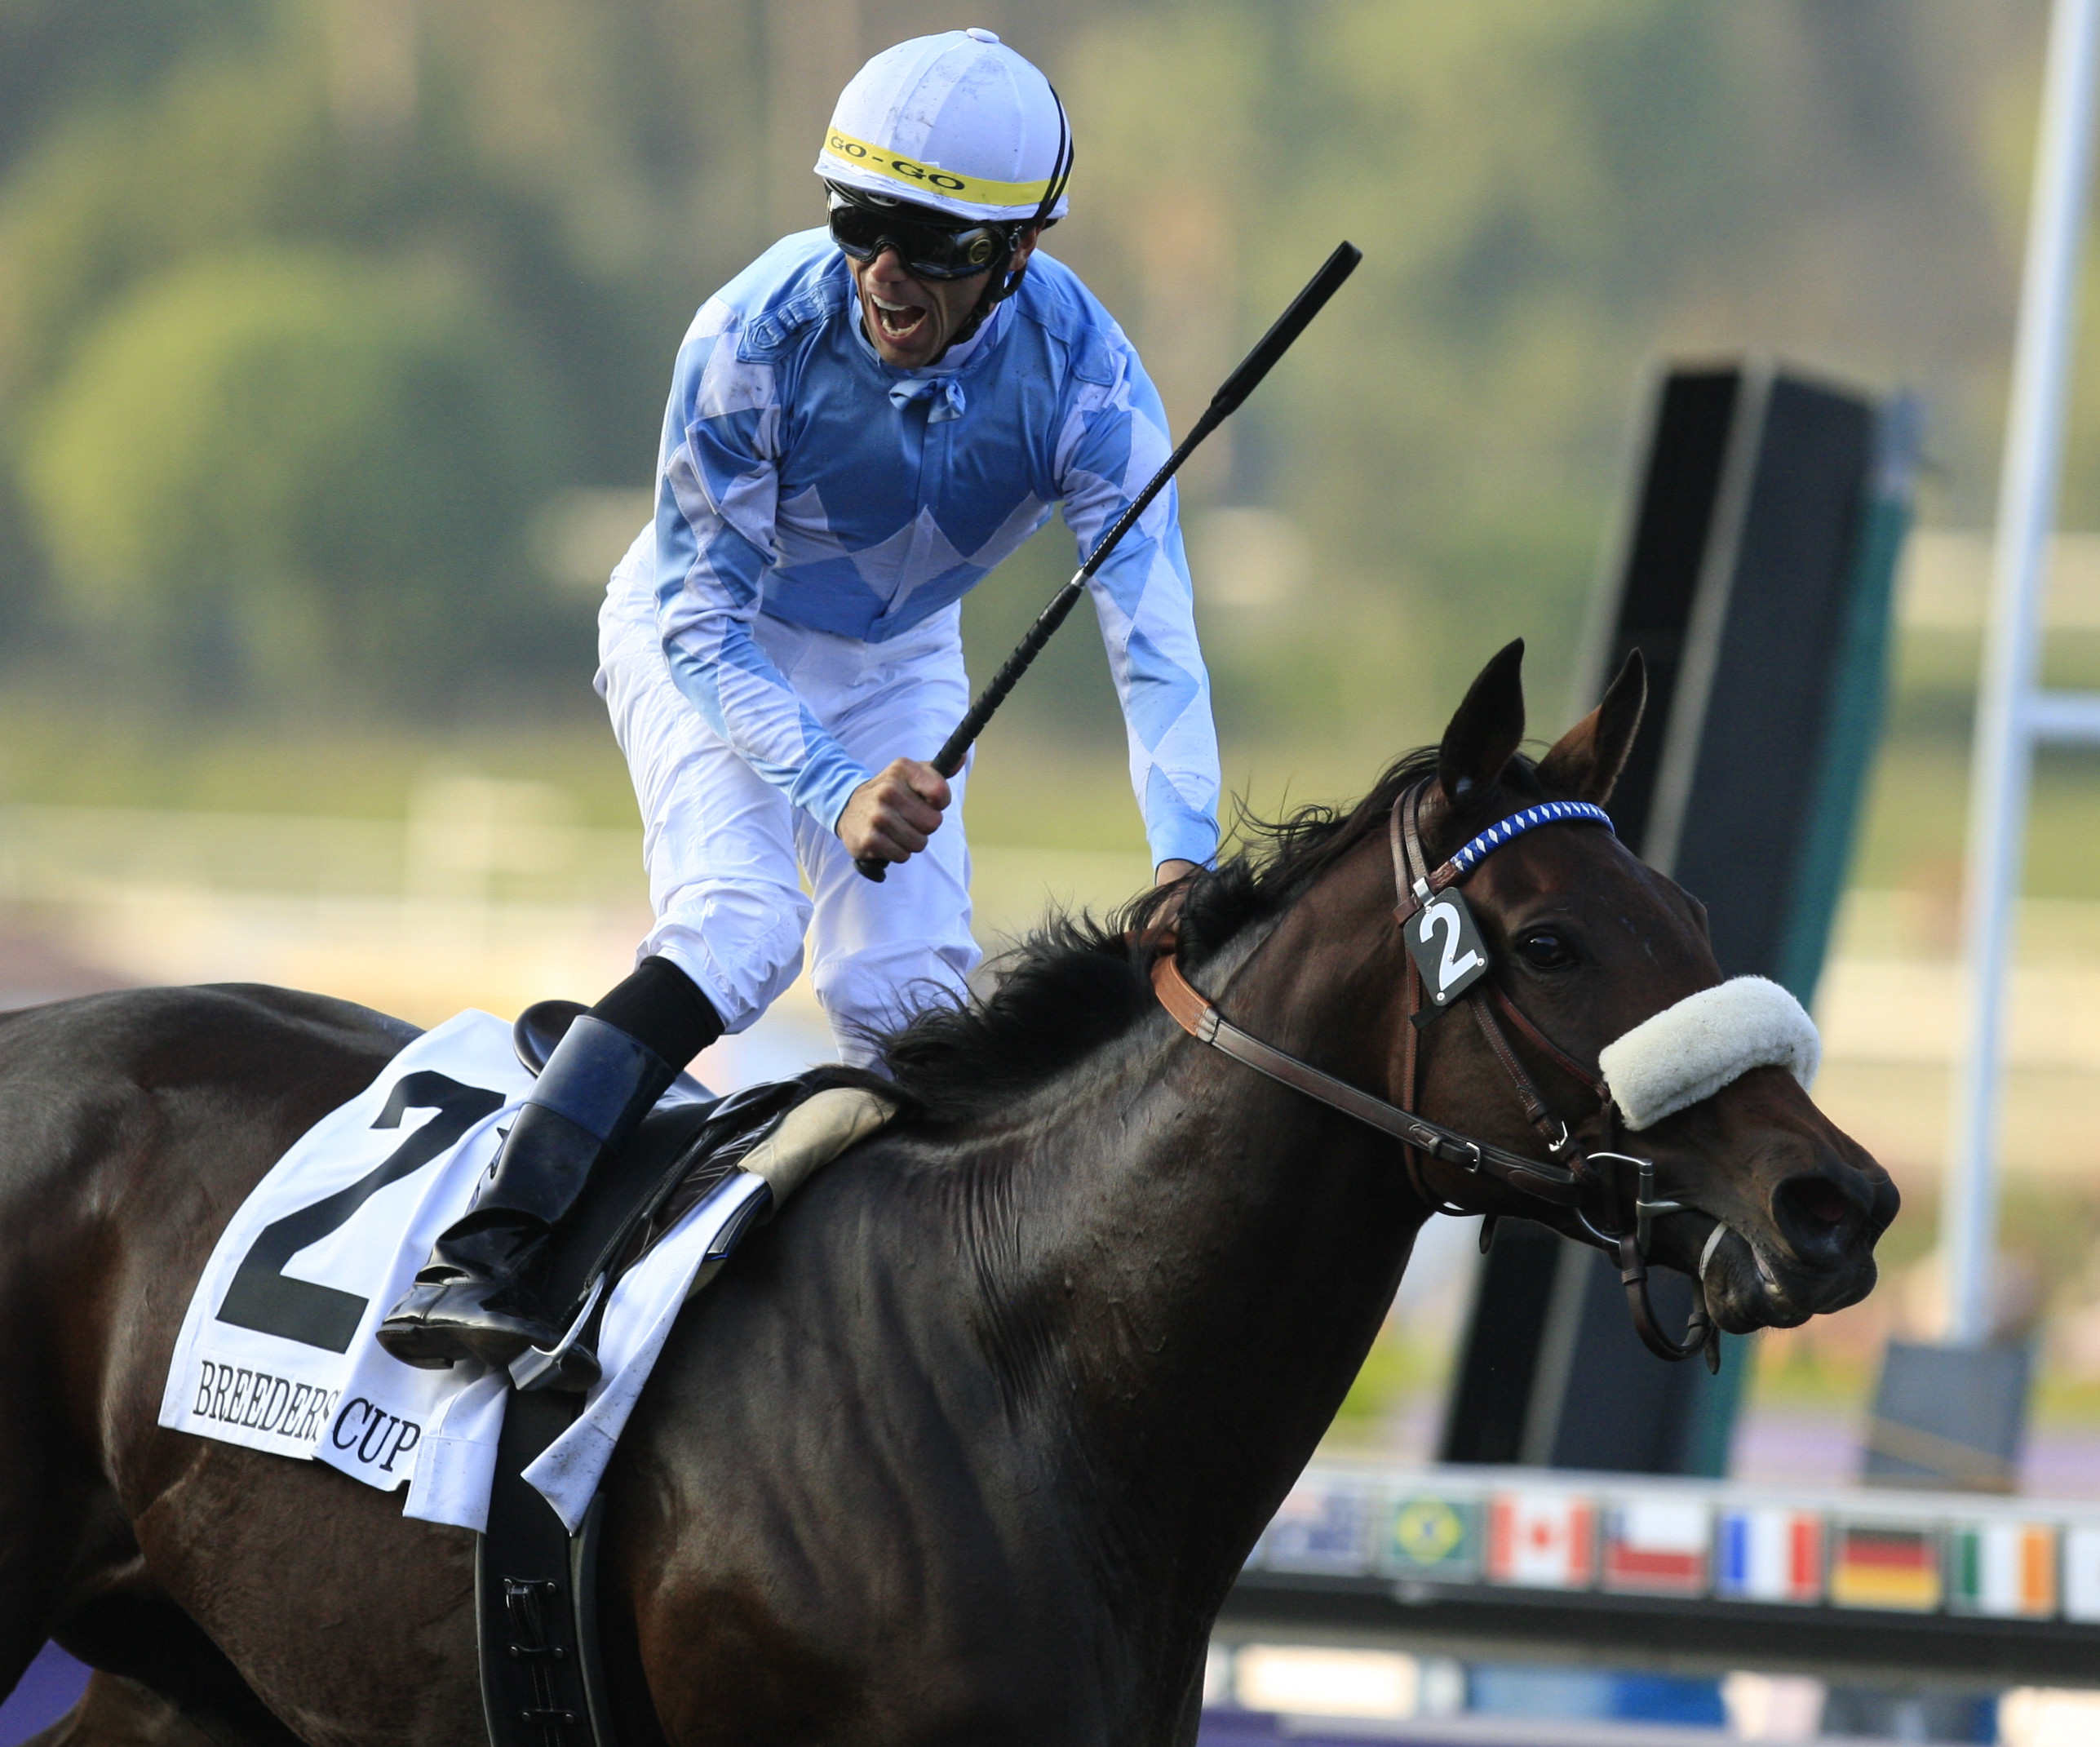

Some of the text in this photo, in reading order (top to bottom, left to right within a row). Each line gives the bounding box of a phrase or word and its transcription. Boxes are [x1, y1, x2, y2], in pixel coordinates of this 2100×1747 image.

[1419, 902, 1478, 991] 2
[215, 1071, 506, 1354] 2
[332, 1397, 421, 1472] CUP
